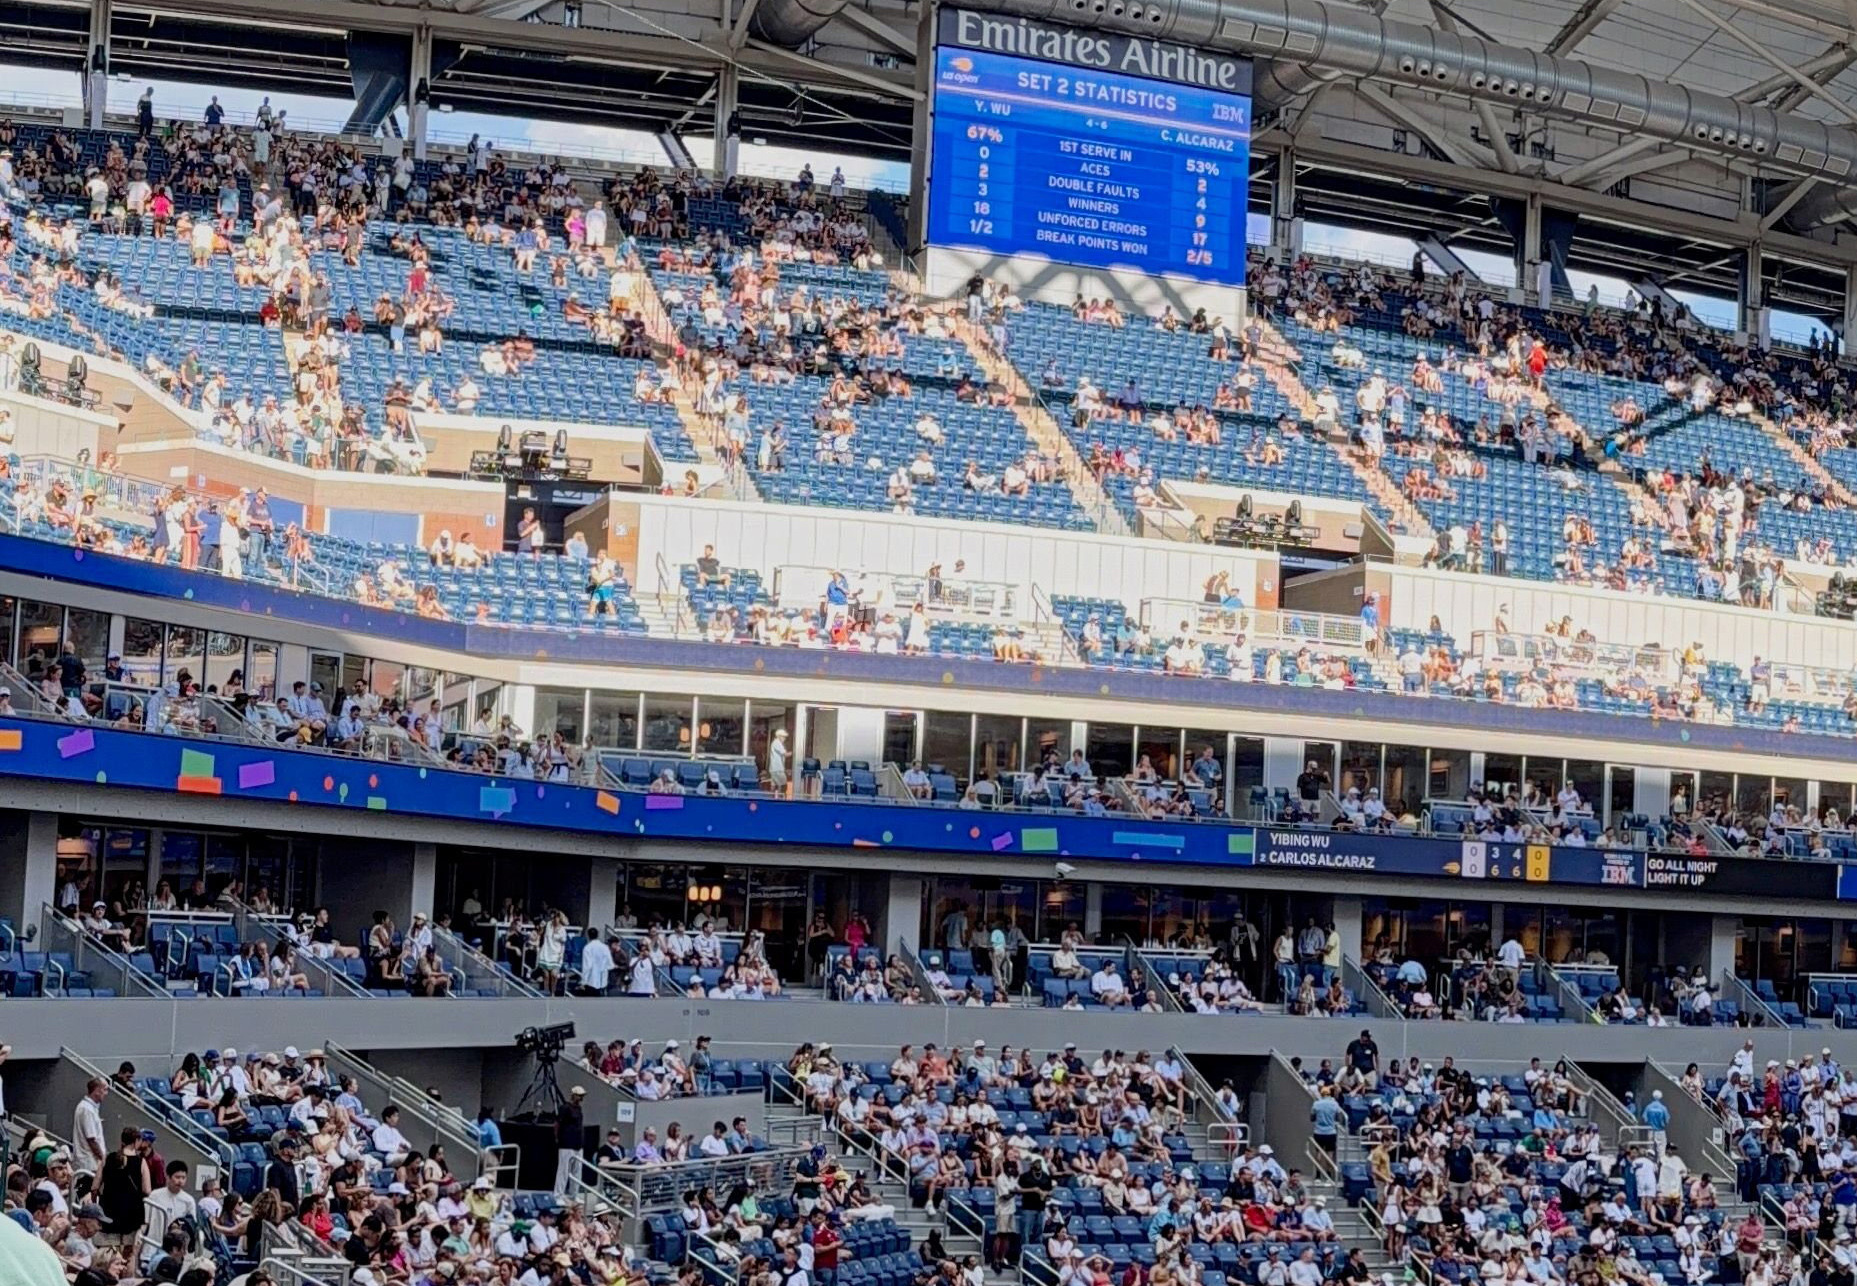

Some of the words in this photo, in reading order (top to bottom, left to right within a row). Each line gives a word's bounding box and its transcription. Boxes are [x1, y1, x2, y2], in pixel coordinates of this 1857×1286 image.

[958, 11, 1112, 68] Emirates
[1120, 40, 1236, 90] Airline
[1018, 72, 1052, 90] SET
[1058, 78, 1068, 93] 2
[1075, 81, 1176, 111] STATISTICS
[975, 100, 987, 112] Y.
[991, 102, 1010, 115] WU
[1213, 104, 1244, 124] IBM
[968, 125, 1003, 142] 67%
[1161, 129, 1172, 141] C.
[1177, 132, 1233, 151] ALCARAZ
[1060, 141, 1078, 153] 1ST
[1081, 144, 1117, 159] SERVE
[1121, 150, 1131, 161] IN
[1186, 159, 1219, 175] 53%
[1081, 163, 1110, 176] ACES
[1049, 176, 1093, 192] DOUBLE
[1097, 183, 1139, 200] FAULTS
[979, 183, 987, 196] 3
[1069, 198, 1119, 214] WINNERS
[974, 201, 990, 214] 18
[1039, 212, 1099, 229] UNFORCED
[1102, 220, 1147, 236] ERRORS
[1193, 233, 1207, 246] 17
[971, 219, 992, 234] 1/2
[1037, 230, 1074, 244] BREAK
[1079, 236, 1118, 250] POINTS
[1122, 242, 1147, 254] WON
[1187, 250, 1212, 264] 2/5
[1271, 833, 1309, 846] YIBING
[1311, 835, 1329, 847] WU
[1269, 851, 1316, 865] CARLOS
[1318, 854, 1375, 868] ALCARAZ
[1648, 859, 1664, 869] GO
[1666, 860, 1685, 871] ALL
[1687, 862, 1717, 872] NIGHT
[1602, 865, 1635, 884] IBM
[1648, 873, 1677, 883] LIGHT
[1680, 874, 1689, 884] IT
[1691, 875, 1704, 885] UP
